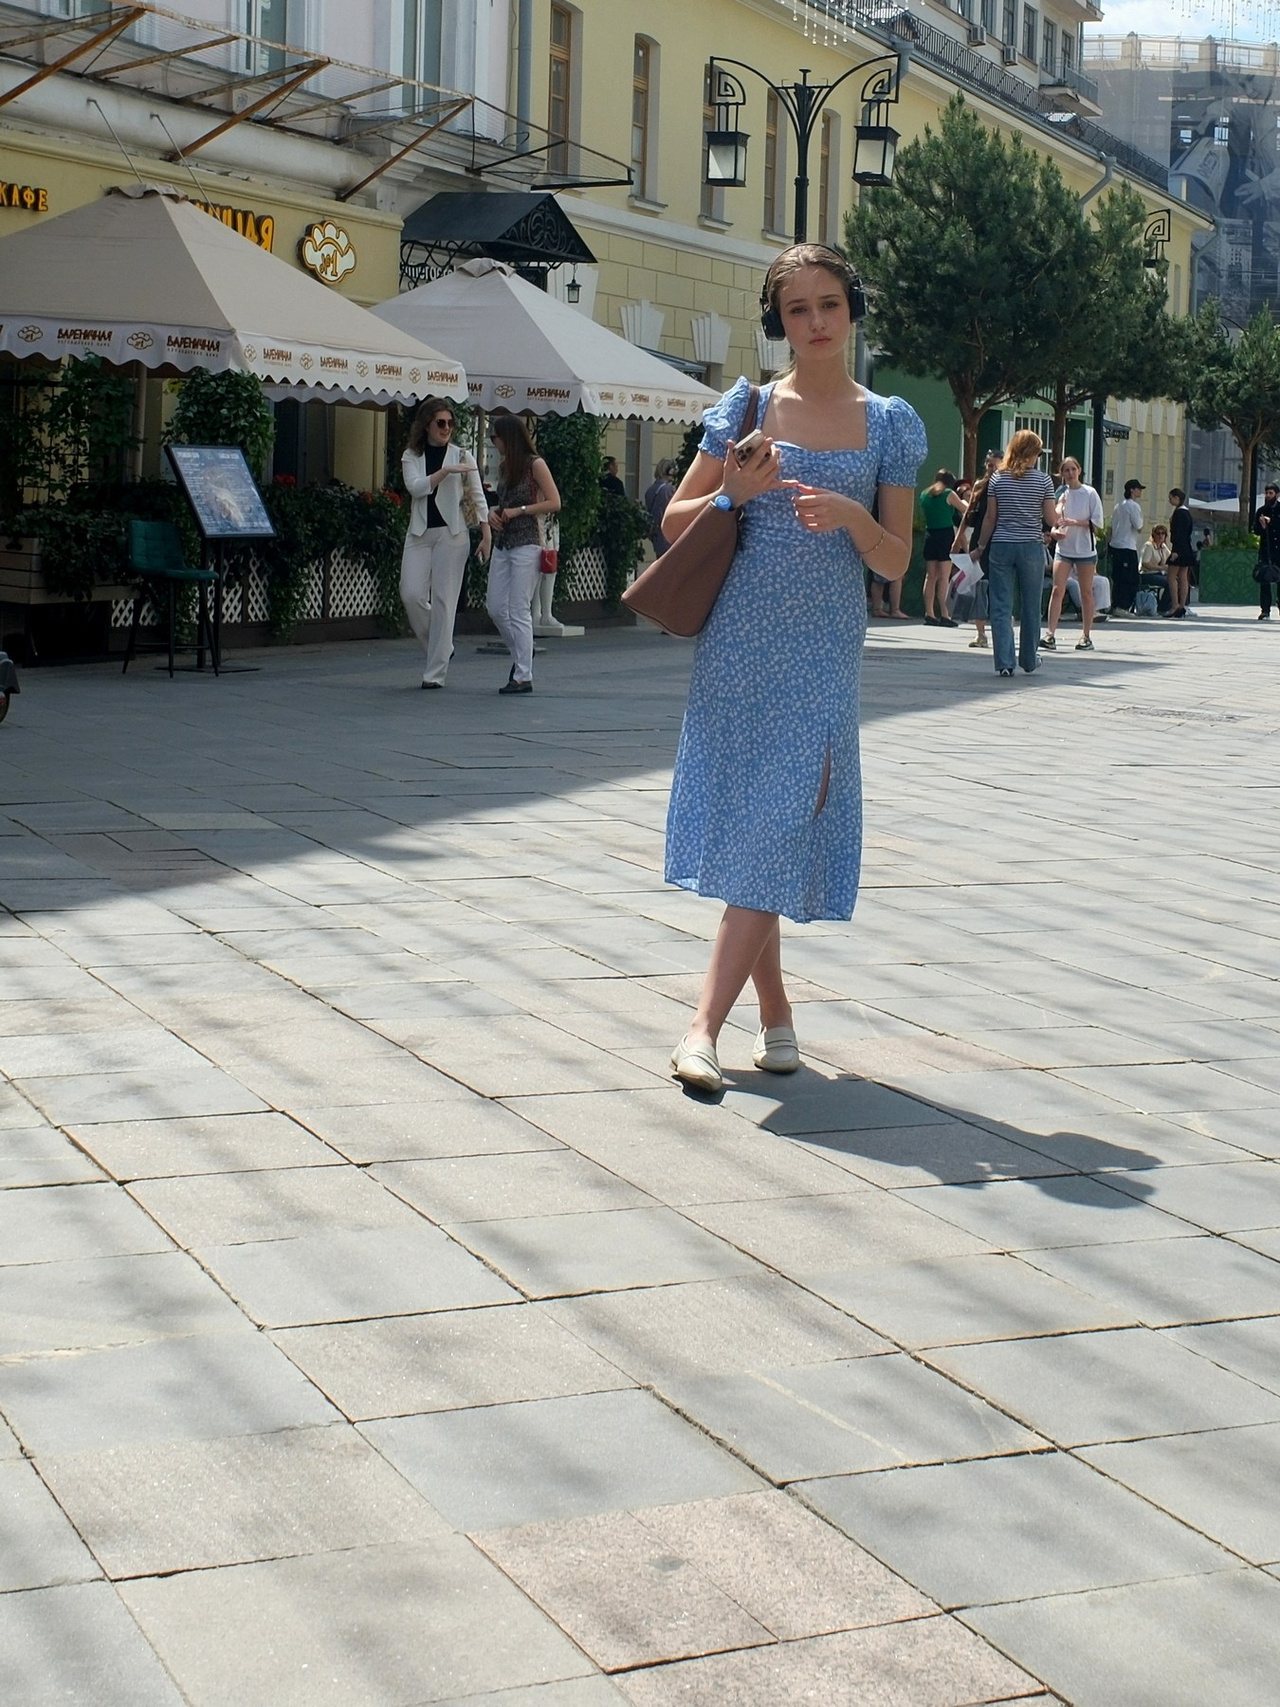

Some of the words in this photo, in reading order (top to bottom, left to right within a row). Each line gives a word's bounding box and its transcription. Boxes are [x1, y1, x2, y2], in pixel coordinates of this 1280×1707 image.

[0, 181, 49, 212] КАФЕ
[57, 328, 113, 342] ВАРЕНИЧНАЯ
[166, 335, 221, 352] ВАРЕНИЧНАЯ
[526, 387, 571, 399] ВАРЕНИЧНАЯ
